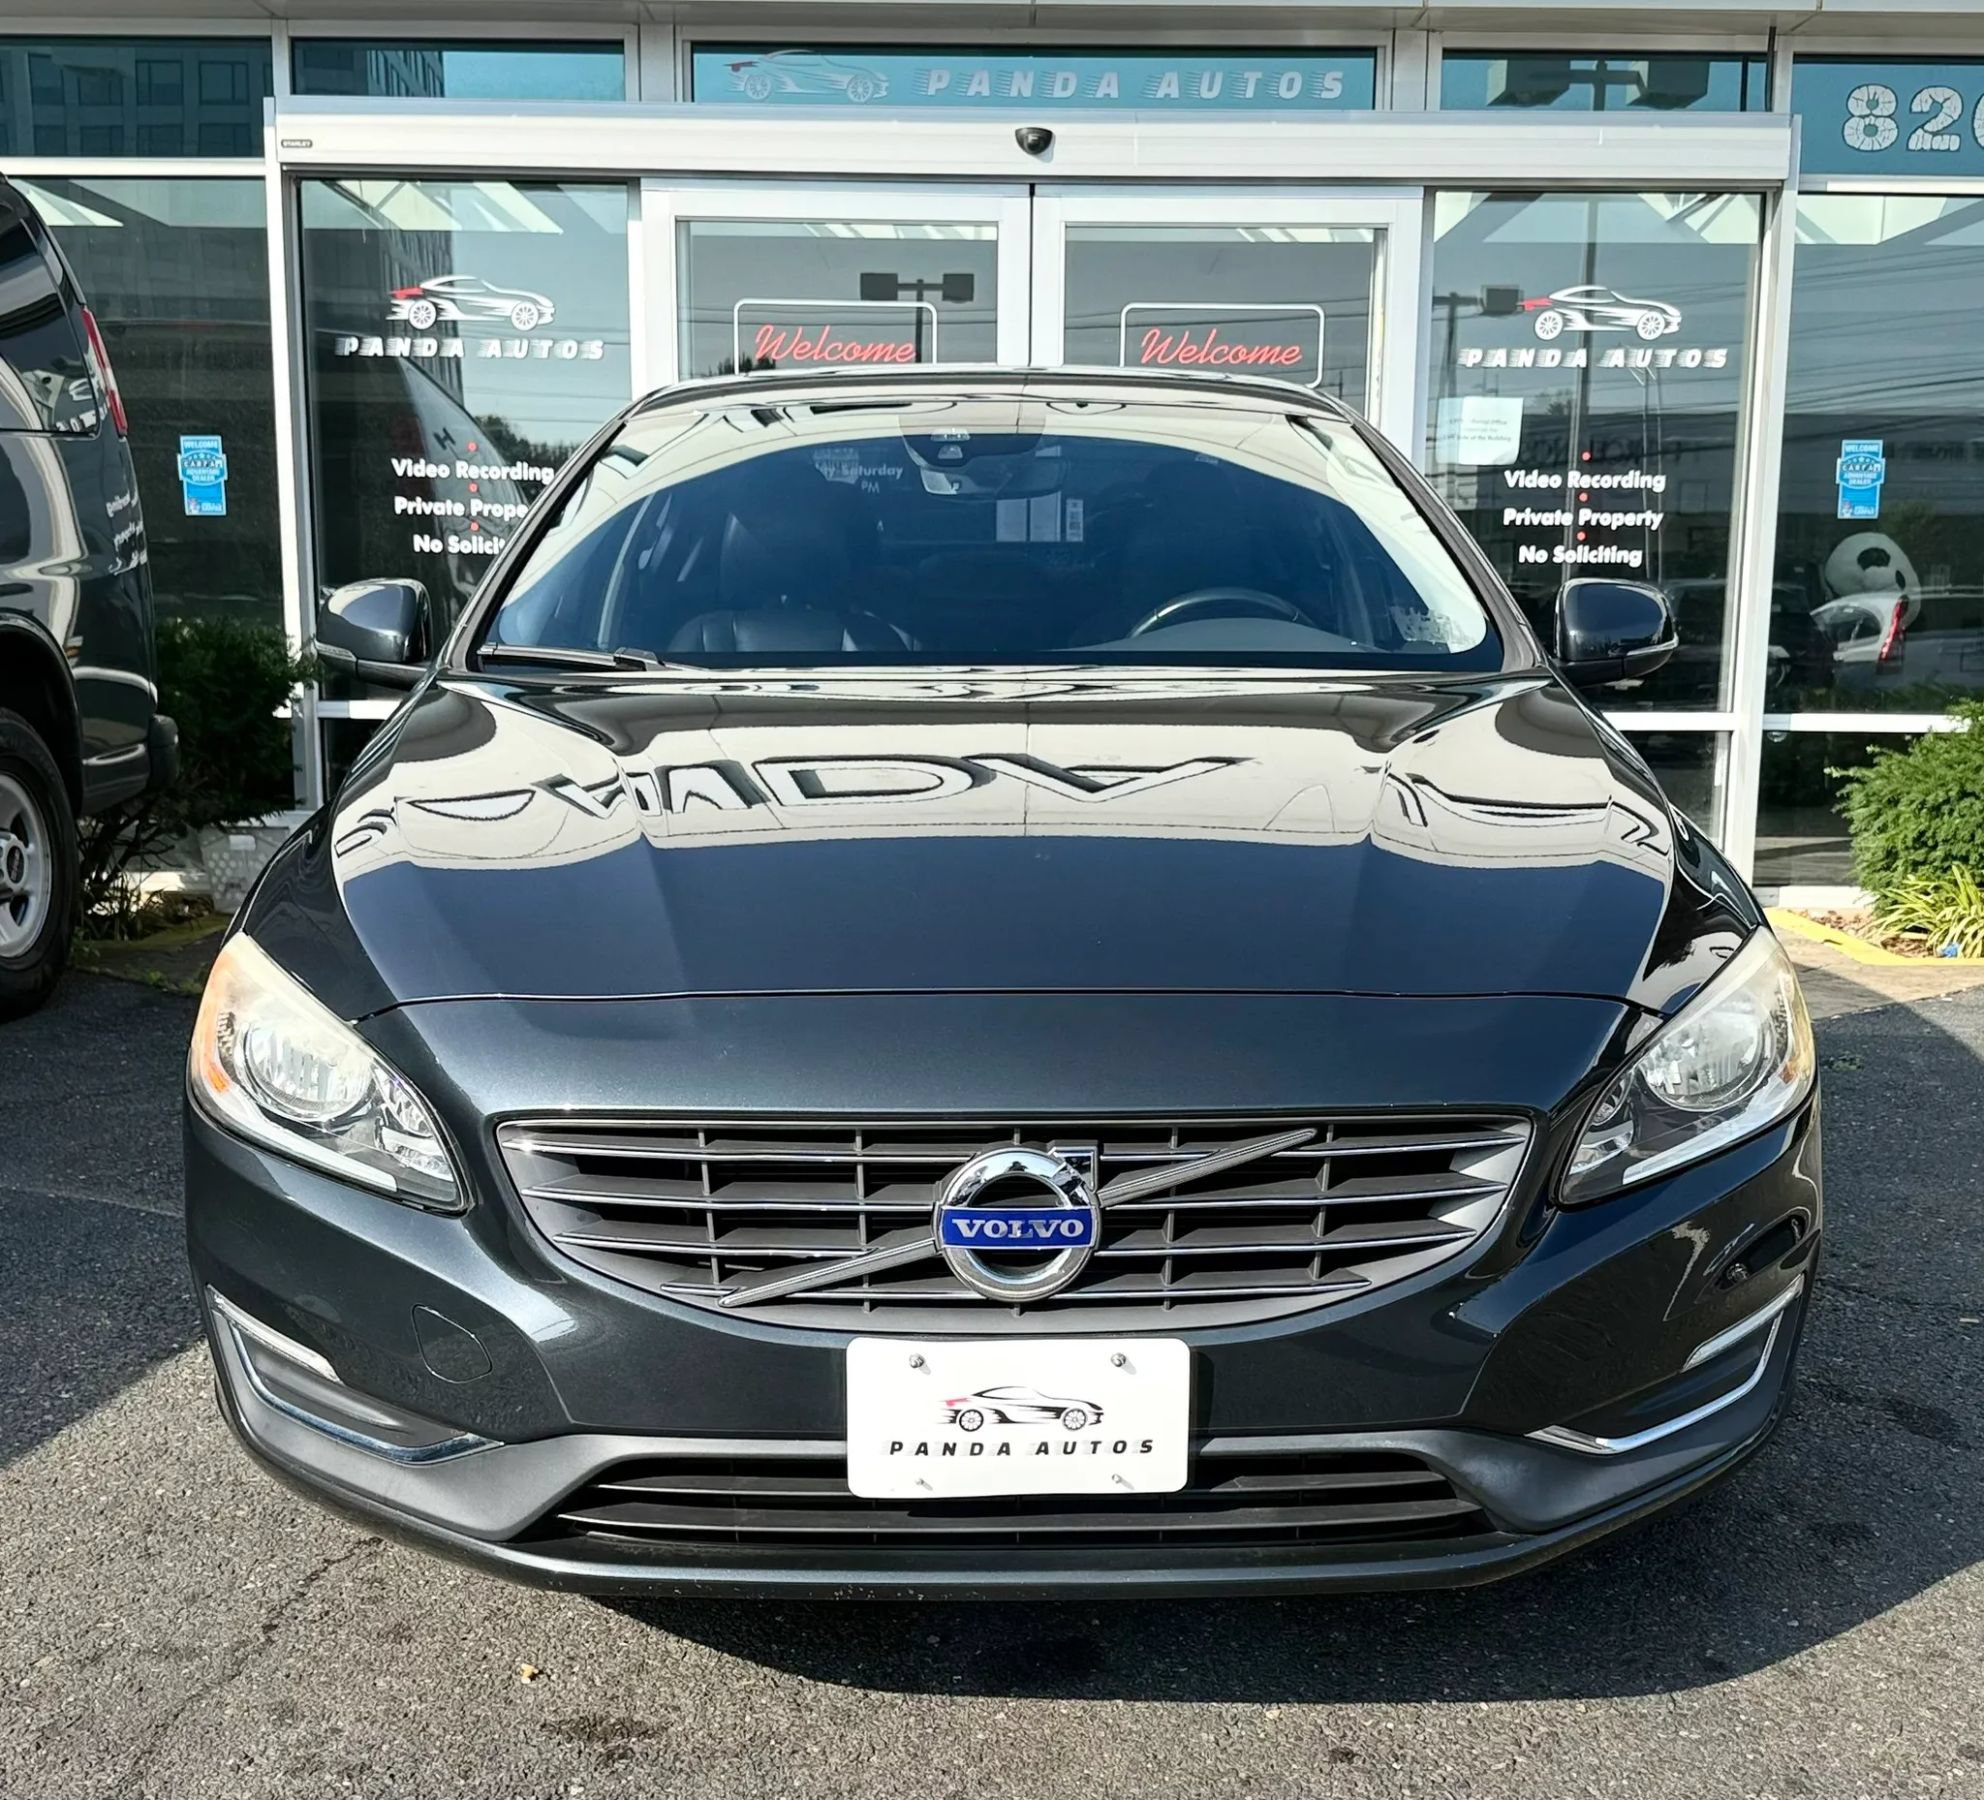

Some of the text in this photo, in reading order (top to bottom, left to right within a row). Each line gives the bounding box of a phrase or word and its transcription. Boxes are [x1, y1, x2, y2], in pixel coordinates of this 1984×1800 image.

[914, 70, 1343, 99] PANDA AUTOS
[1843, 83, 1984, 152] 82
[335, 336, 604, 359] PANDA AUTOS
[755, 324, 917, 363] Welcome
[1141, 328, 1303, 366] Welcome
[1457, 348, 1728, 368] PANDA AUTOS
[391, 458, 555, 485] Video Recording
[1504, 470, 1666, 493] Video Recording
[394, 496, 528, 522] Private Prope
[1503, 508, 1664, 531] Private Property
[413, 534, 505, 555] No Solici
[1518, 545, 1643, 568] No Soliciting
[952, 1218, 1084, 1239] VOLVO
[884, 1439, 1153, 1457] PANDA AUTOS
